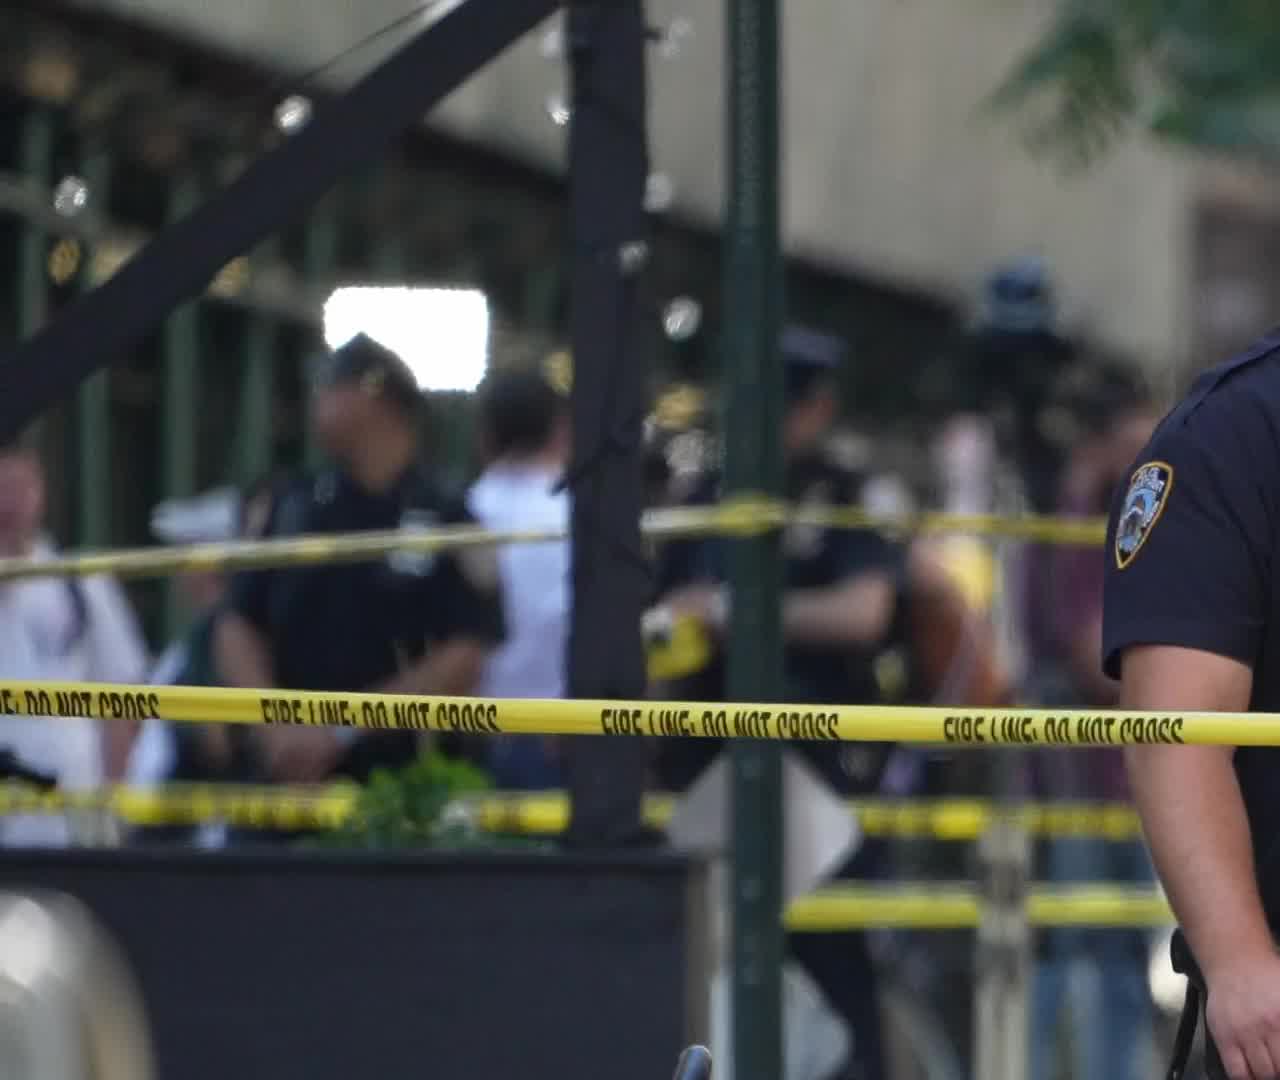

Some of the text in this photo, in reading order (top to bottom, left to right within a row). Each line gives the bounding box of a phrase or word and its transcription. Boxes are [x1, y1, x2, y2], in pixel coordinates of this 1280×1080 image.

[25, 691, 51, 716] DO
[56, 692, 91, 718] NOT
[99, 692, 160, 720] CROSS
[261, 699, 303, 724] FIRE
[362, 702, 389, 728] DO
[394, 702, 429, 729] NOT
[436, 704, 498, 732] CROSS
[601, 709, 642, 735] FIRE
[702, 711, 728, 737] DO
[734, 712, 771, 737] NOT
[777, 712, 840, 740] CROSS
[944, 717, 984, 742] FIRE
[1044, 718, 1070, 743] DO
[1077, 718, 1115, 744] NOT
[1120, 718, 1184, 744] CROSS
